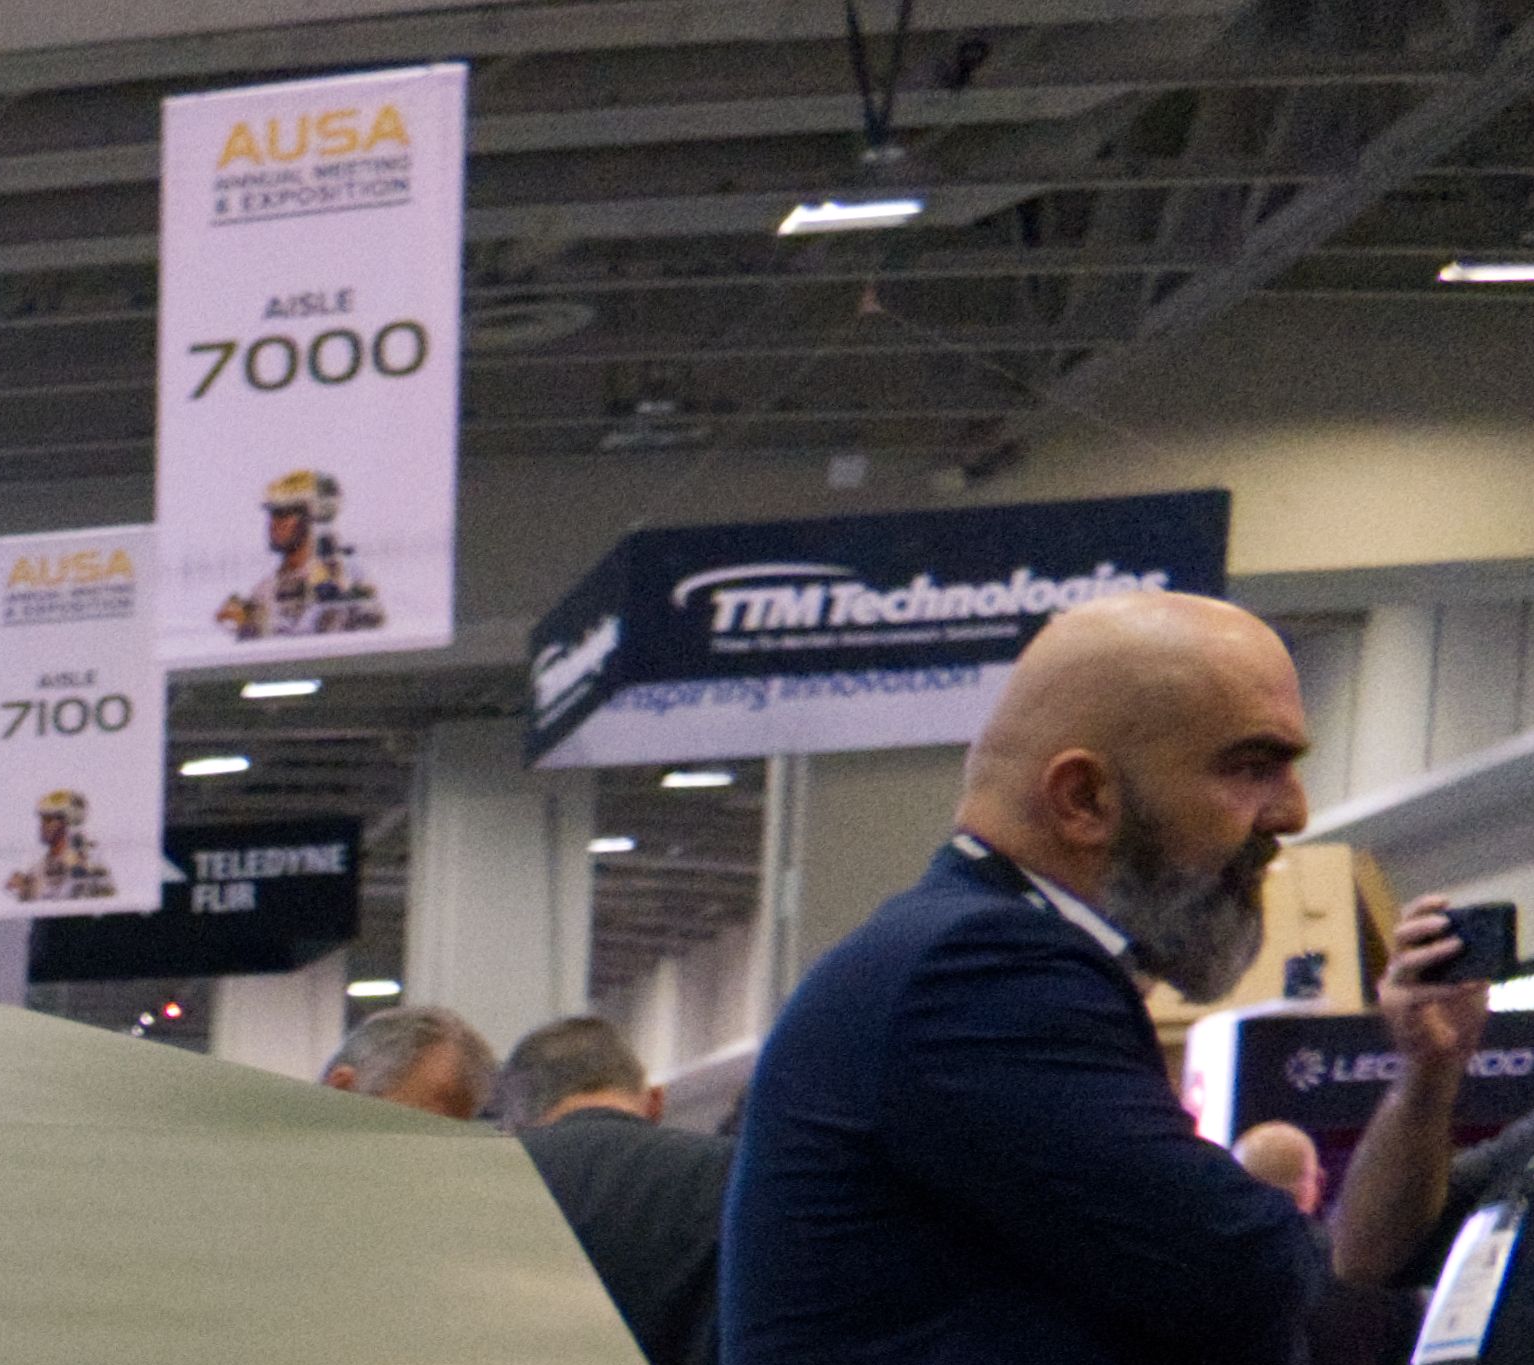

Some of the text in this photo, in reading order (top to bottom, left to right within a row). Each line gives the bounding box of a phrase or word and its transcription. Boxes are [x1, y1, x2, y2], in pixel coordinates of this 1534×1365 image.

[216, 103, 412, 171] AUSA
[261, 288, 354, 320] AISLE
[189, 318, 430, 400] 7000
[7, 548, 135, 590] AUSA
[712, 584, 825, 633] TTM
[0, 693, 133, 741] 7100
[193, 843, 350, 880] TELEDYNE
